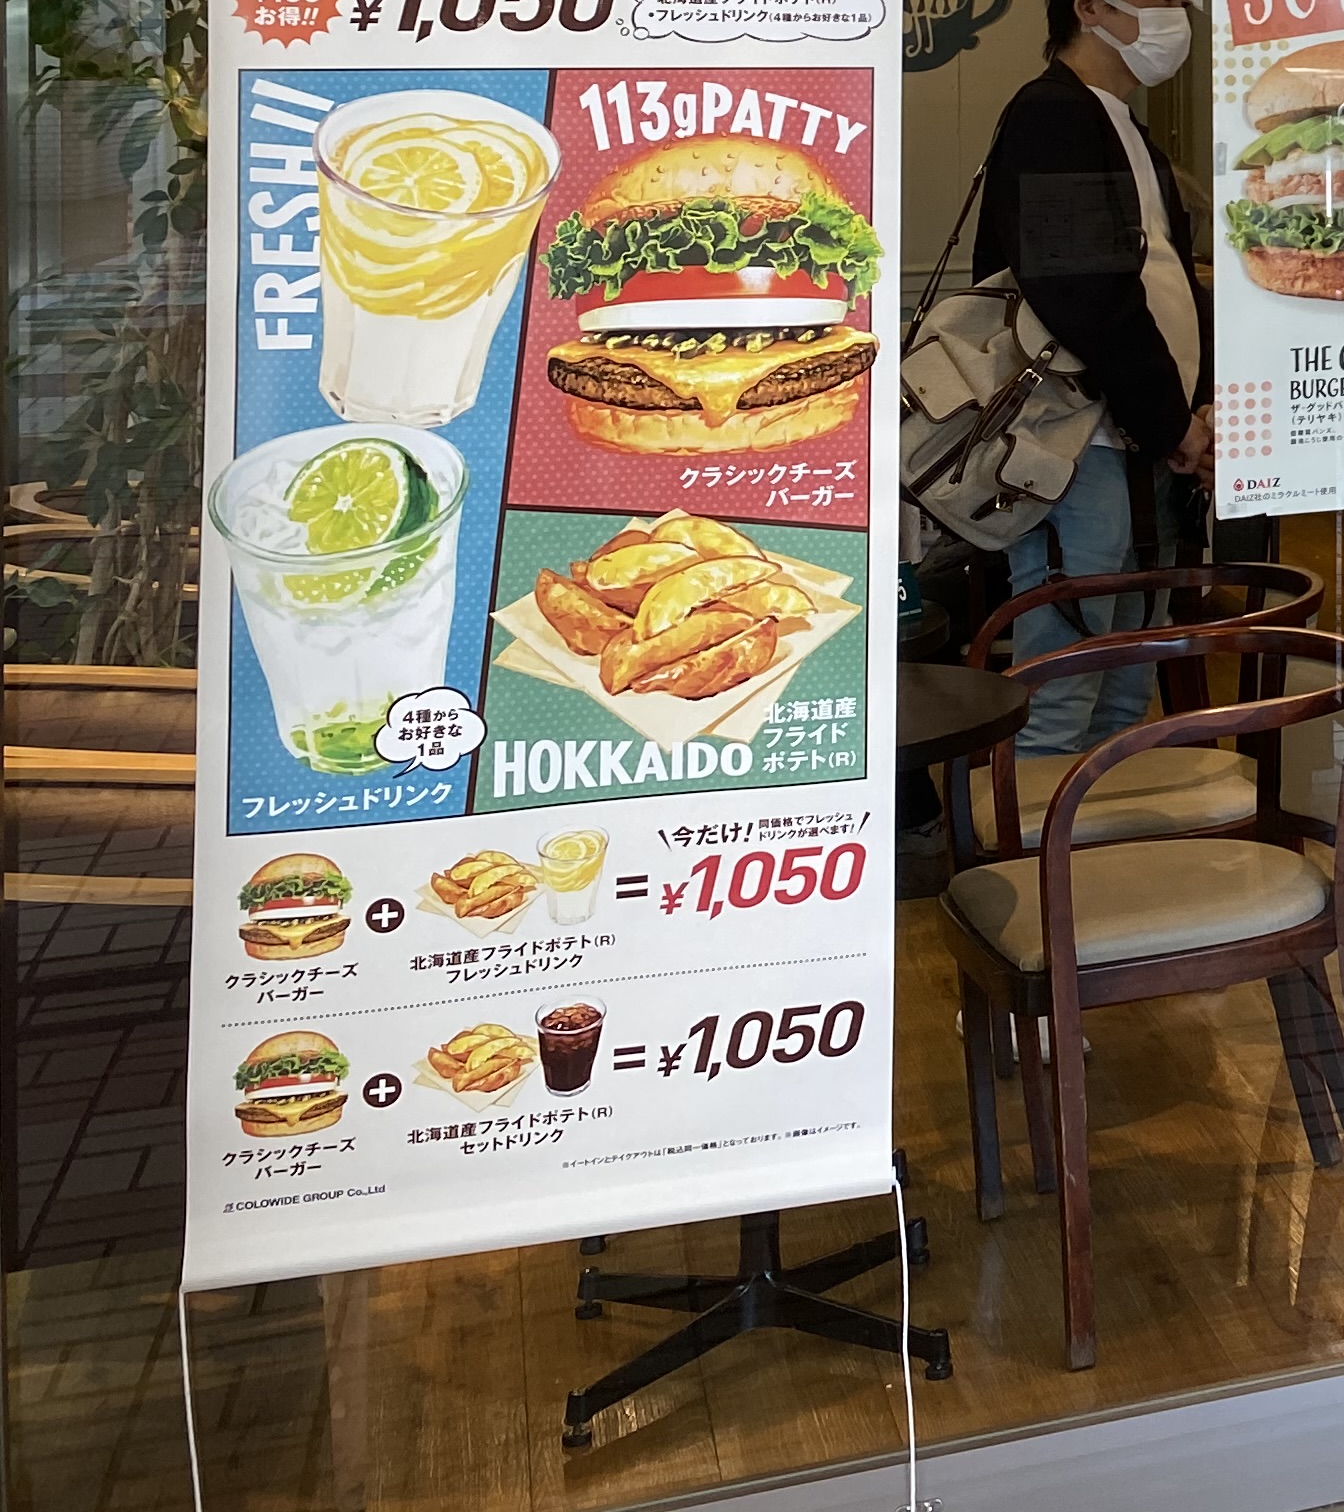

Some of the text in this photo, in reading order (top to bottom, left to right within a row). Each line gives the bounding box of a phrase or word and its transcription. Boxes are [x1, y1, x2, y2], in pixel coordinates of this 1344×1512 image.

[254, 6, 319, 26] お得!!
[1290, 346, 1332, 374] THE
[678, 460, 856, 489] クラシックチーズ
[1247, 477, 1281, 490] DAIZ
[766, 485, 855, 507] バーガー
[402, 708, 460, 726] 4種から
[763, 696, 857, 723] 北海道産
[398, 722, 463, 743] お好きな
[763, 723, 848, 748] フライド
[417, 740, 444, 758] 1品
[492, 740, 753, 799] HOKKAIDO
[241, 782, 453, 820] フレッシュドリンク
[759, 812, 853, 829] 同価格でフレッシュ
[672, 822, 754, 847] 今だけ!
[660, 843, 866, 920] ¥1,050
[224, 961, 359, 992] クラシックチーズ
[445, 951, 585, 986] フレッシュドリンク
[256, 984, 325, 1005] バーガー
[656, 1000, 866, 1083] ¥1,050
[220, 1136, 357, 1168] クラシックチーズ
[459, 1126, 565, 1157] セットドリンク
[254, 1159, 323, 1181] バーガー
[236, 1195, 300, 1211] COLOWIDE
[303, 1190, 344, 1203] GROUP
